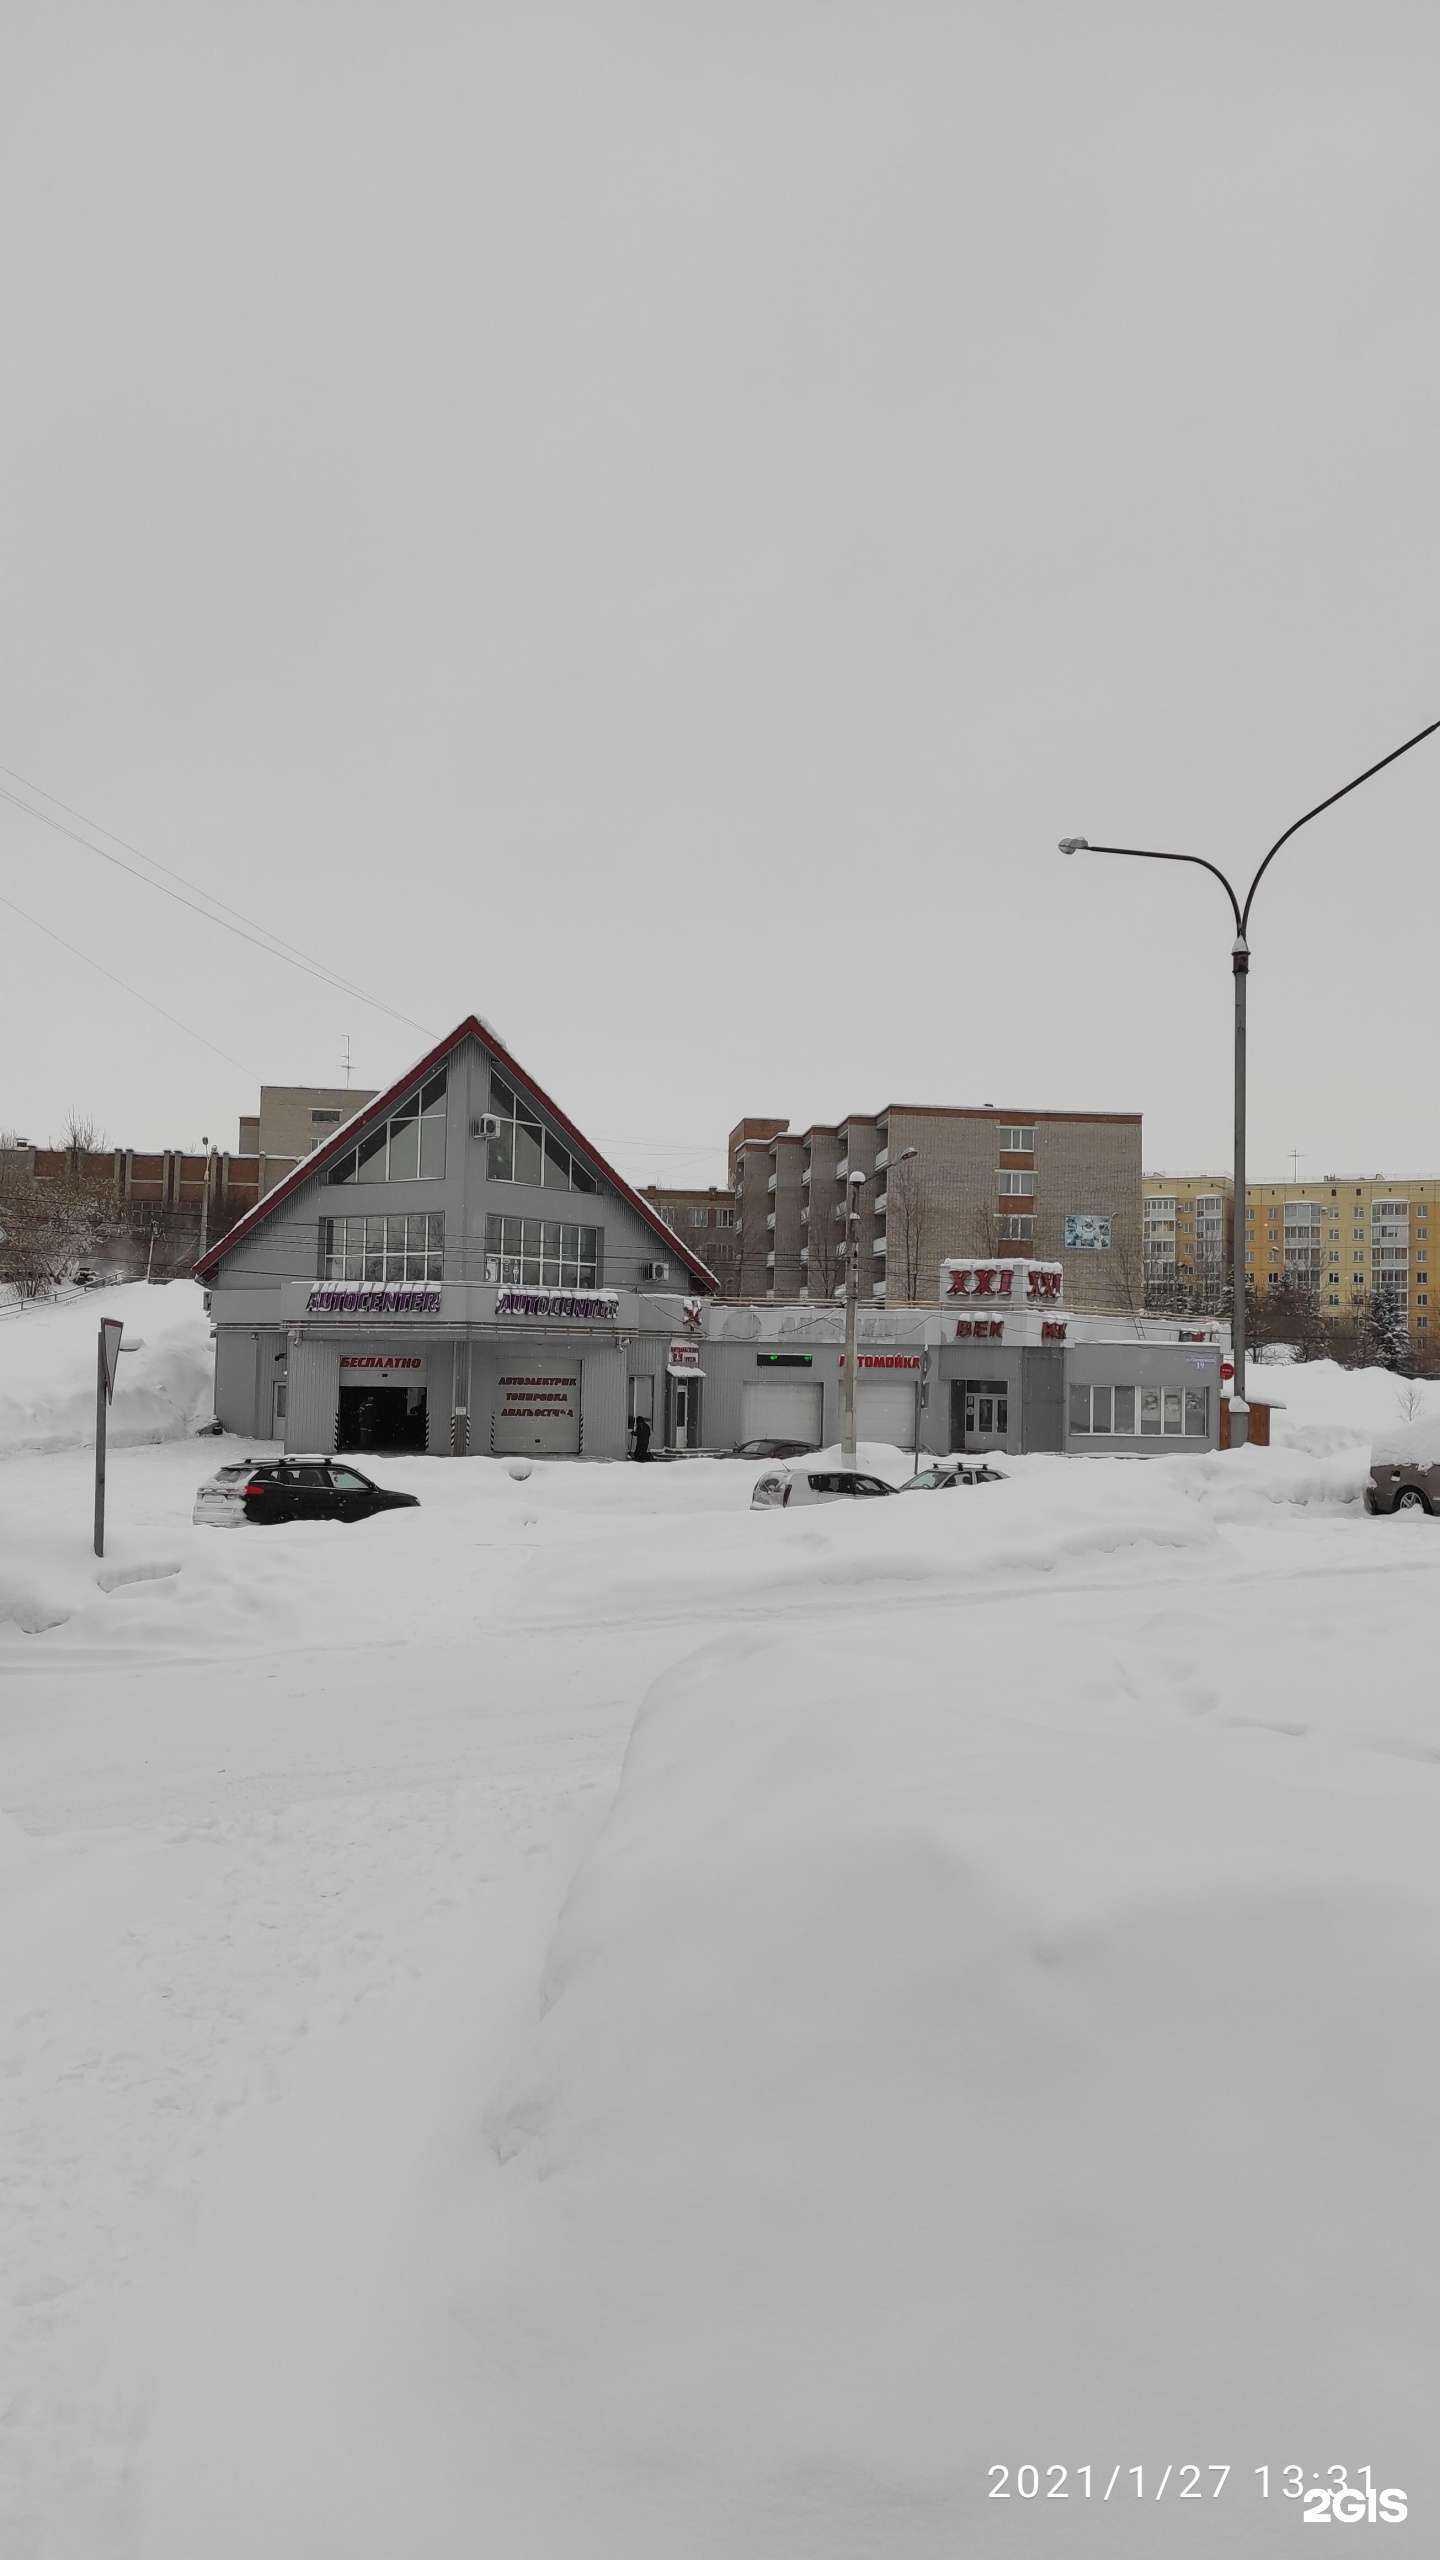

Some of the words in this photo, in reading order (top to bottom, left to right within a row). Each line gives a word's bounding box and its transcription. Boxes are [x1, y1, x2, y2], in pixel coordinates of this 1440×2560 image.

[946, 1269, 1014, 1296] XXI
[306, 1291, 440, 1312] AUTOCENTER
[495, 1294, 619, 1319] AUTOCENTER
[339, 1357, 422, 1369] БЕСПЛАТНО
[838, 1354, 921, 1369] АТОМОЙКА
